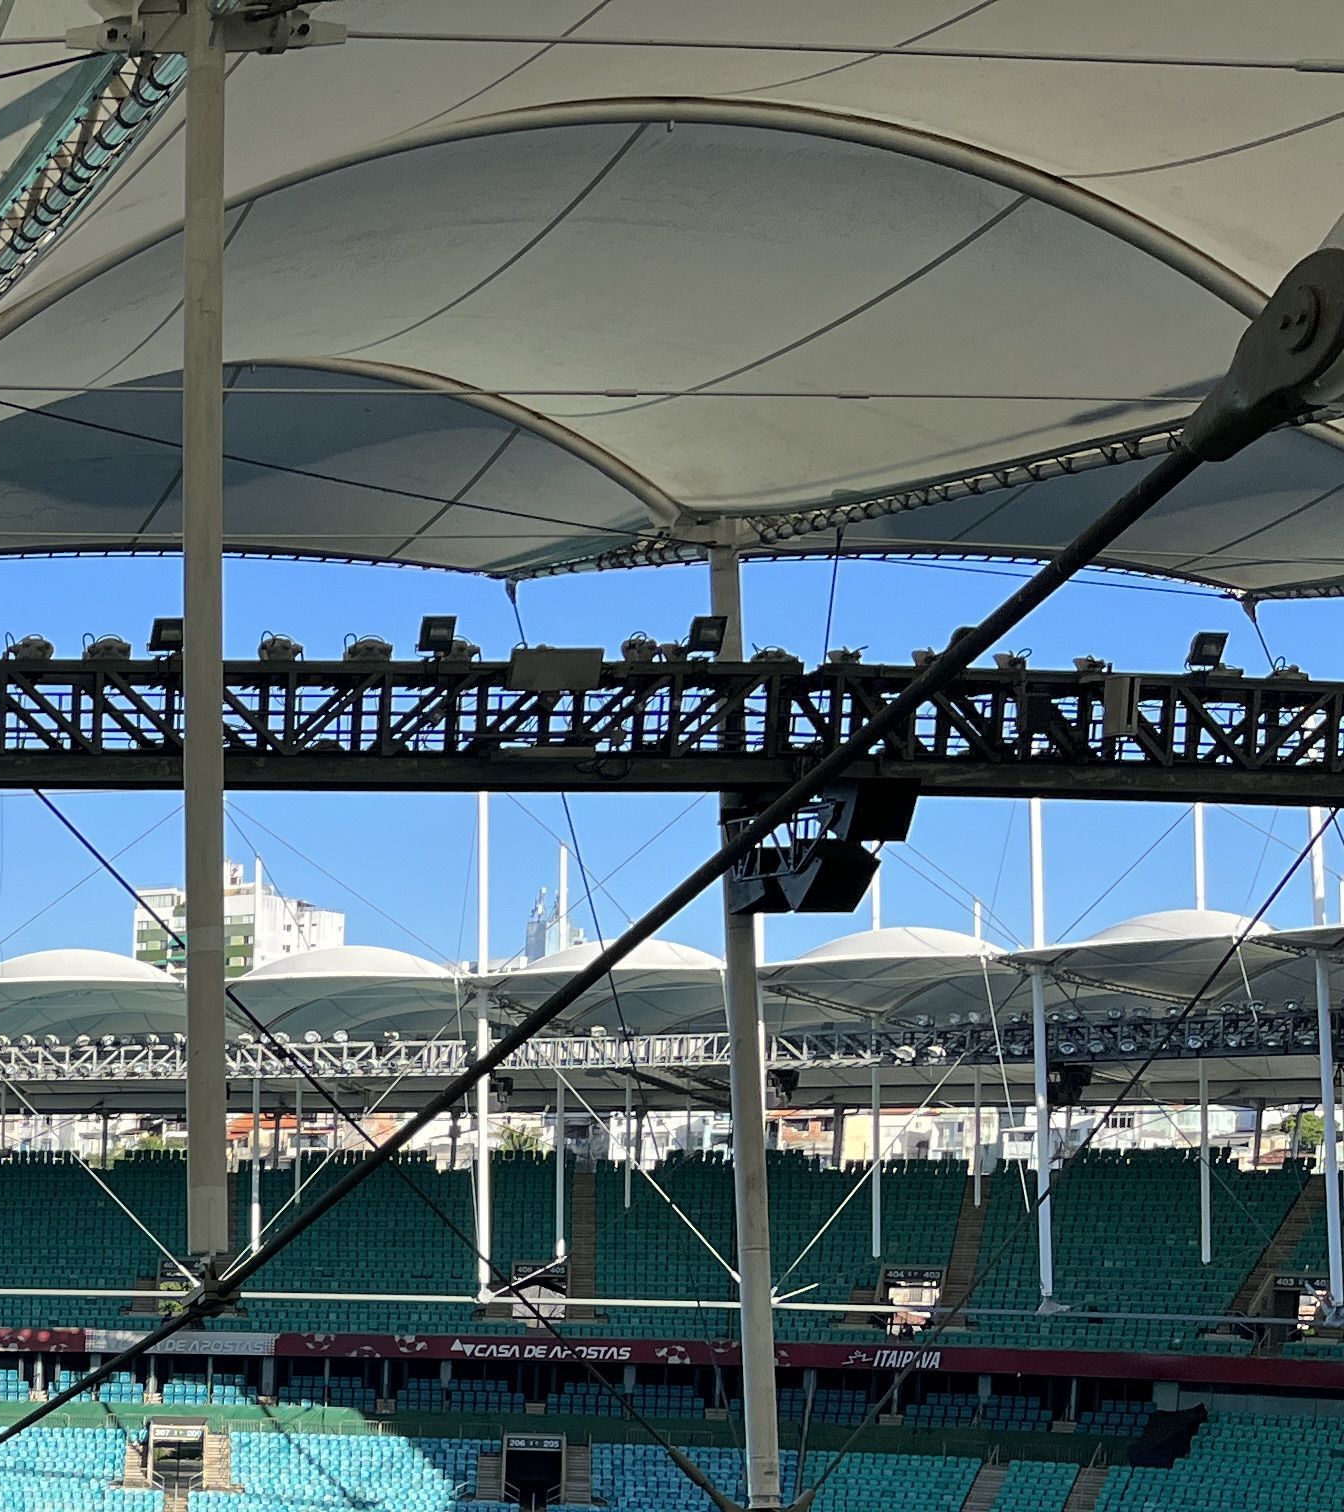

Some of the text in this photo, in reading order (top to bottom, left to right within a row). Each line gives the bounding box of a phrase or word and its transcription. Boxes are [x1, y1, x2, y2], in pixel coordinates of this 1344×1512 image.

[474, 1344, 632, 1361] CASA DE APOSTAS
